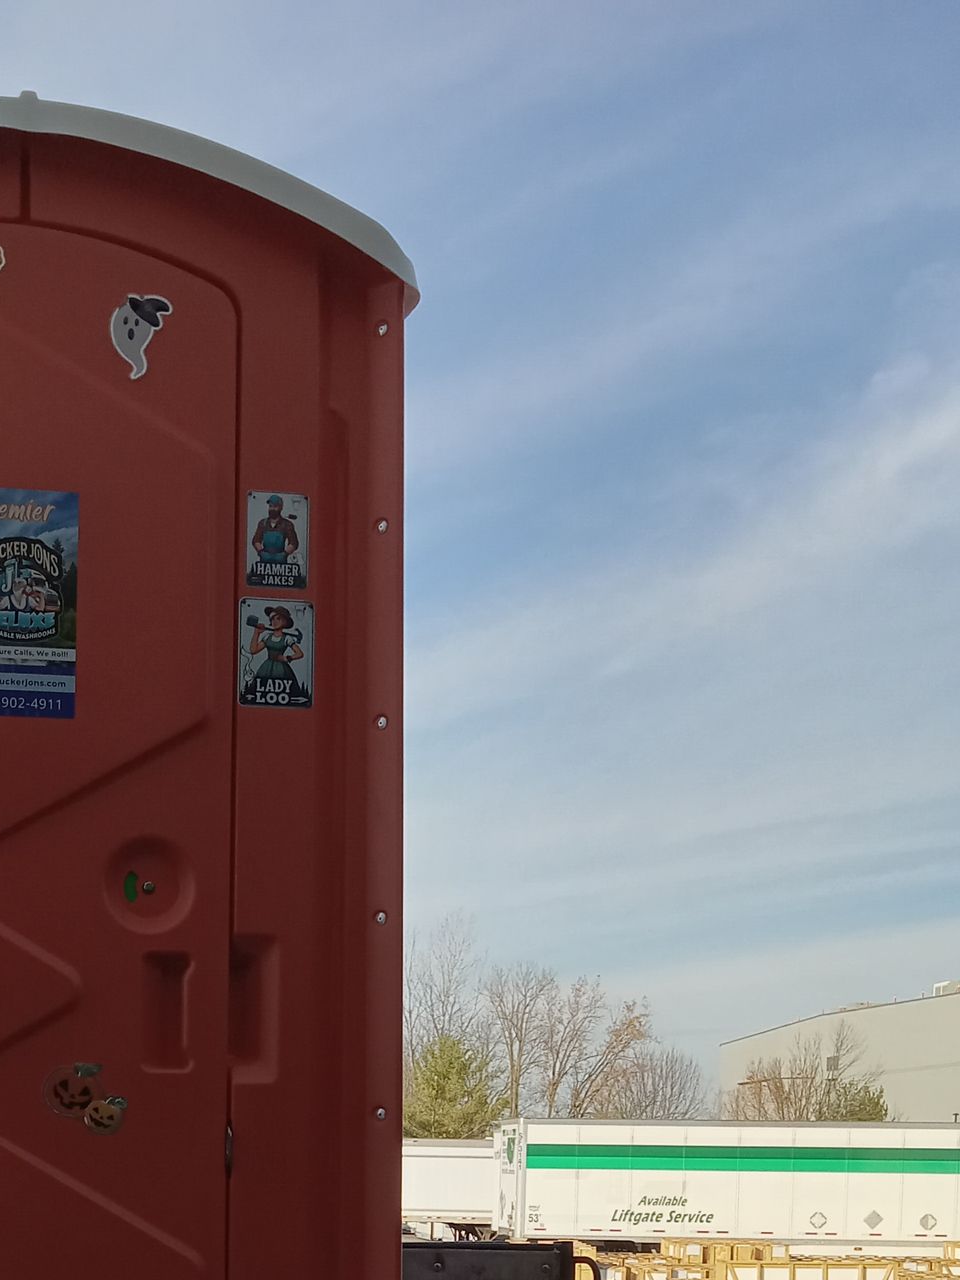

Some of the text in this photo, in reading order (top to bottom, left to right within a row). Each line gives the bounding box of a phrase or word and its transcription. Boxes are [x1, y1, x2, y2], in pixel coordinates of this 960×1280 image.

[29, 543, 60, 577] JONS
[256, 562, 299, 577] HAMMER
[262, 575, 294, 586] JAKES
[15, 628, 56, 640] WASHROOMS
[255, 678, 293, 693] LADY
[255, 692, 290, 704] LOO
[637, 1195, 688, 1207] Available
[611, 1209, 715, 1225] Liftgate Service
